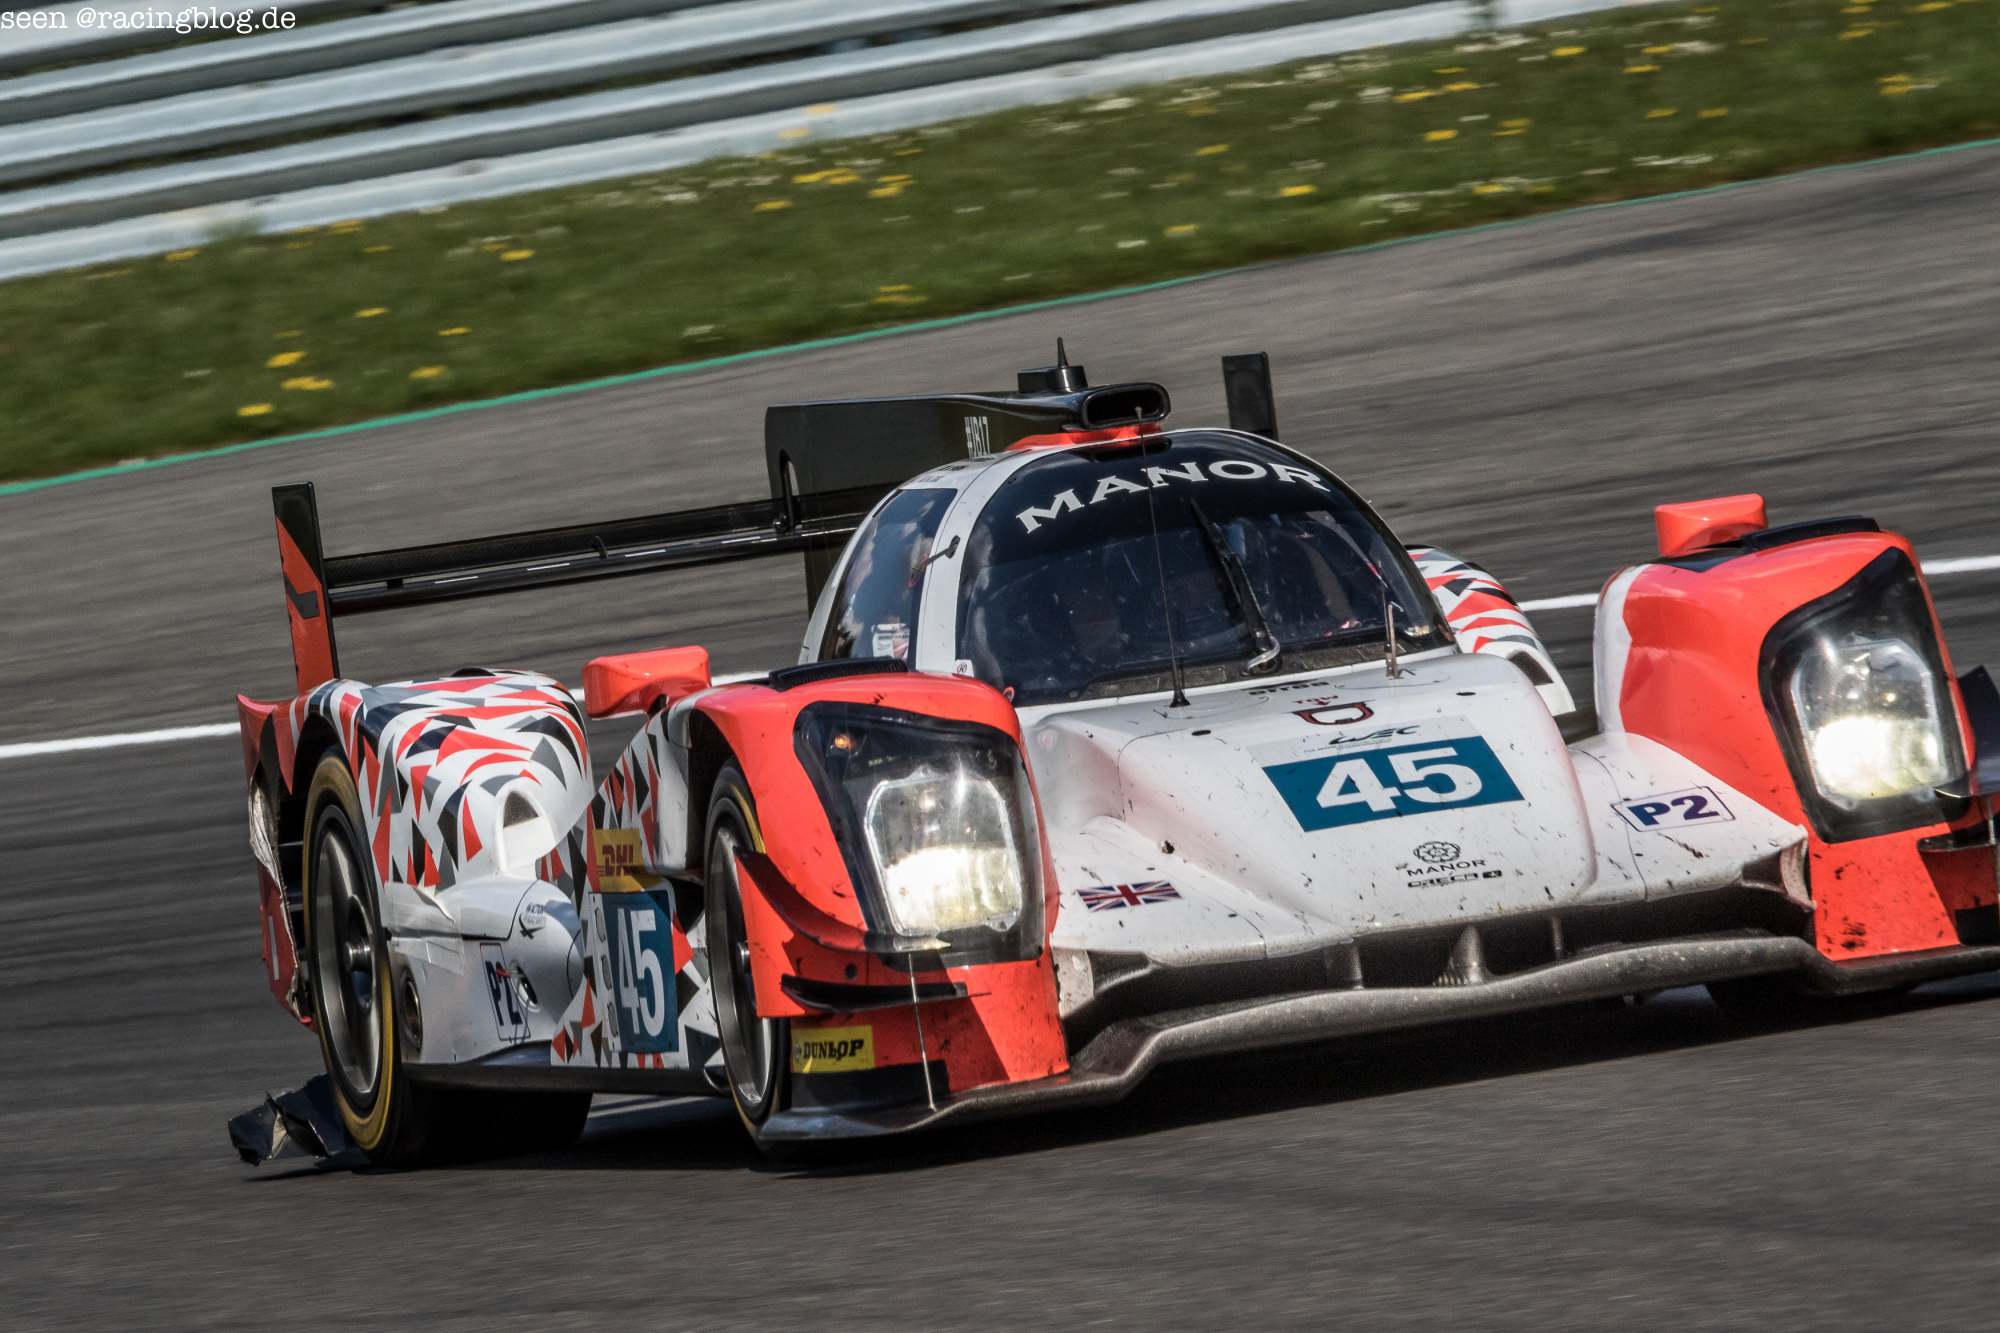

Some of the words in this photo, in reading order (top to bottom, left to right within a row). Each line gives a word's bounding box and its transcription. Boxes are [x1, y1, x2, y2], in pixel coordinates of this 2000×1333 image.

[1016, 460, 1331, 534] MANOR
[1316, 747, 1482, 812] 45
[1627, 795, 1720, 826] P2
[602, 844, 635, 876] DHL
[1407, 860, 1486, 876] MANOR
[617, 908, 665, 1037] 45
[803, 1039, 864, 1061] DUNLOP
